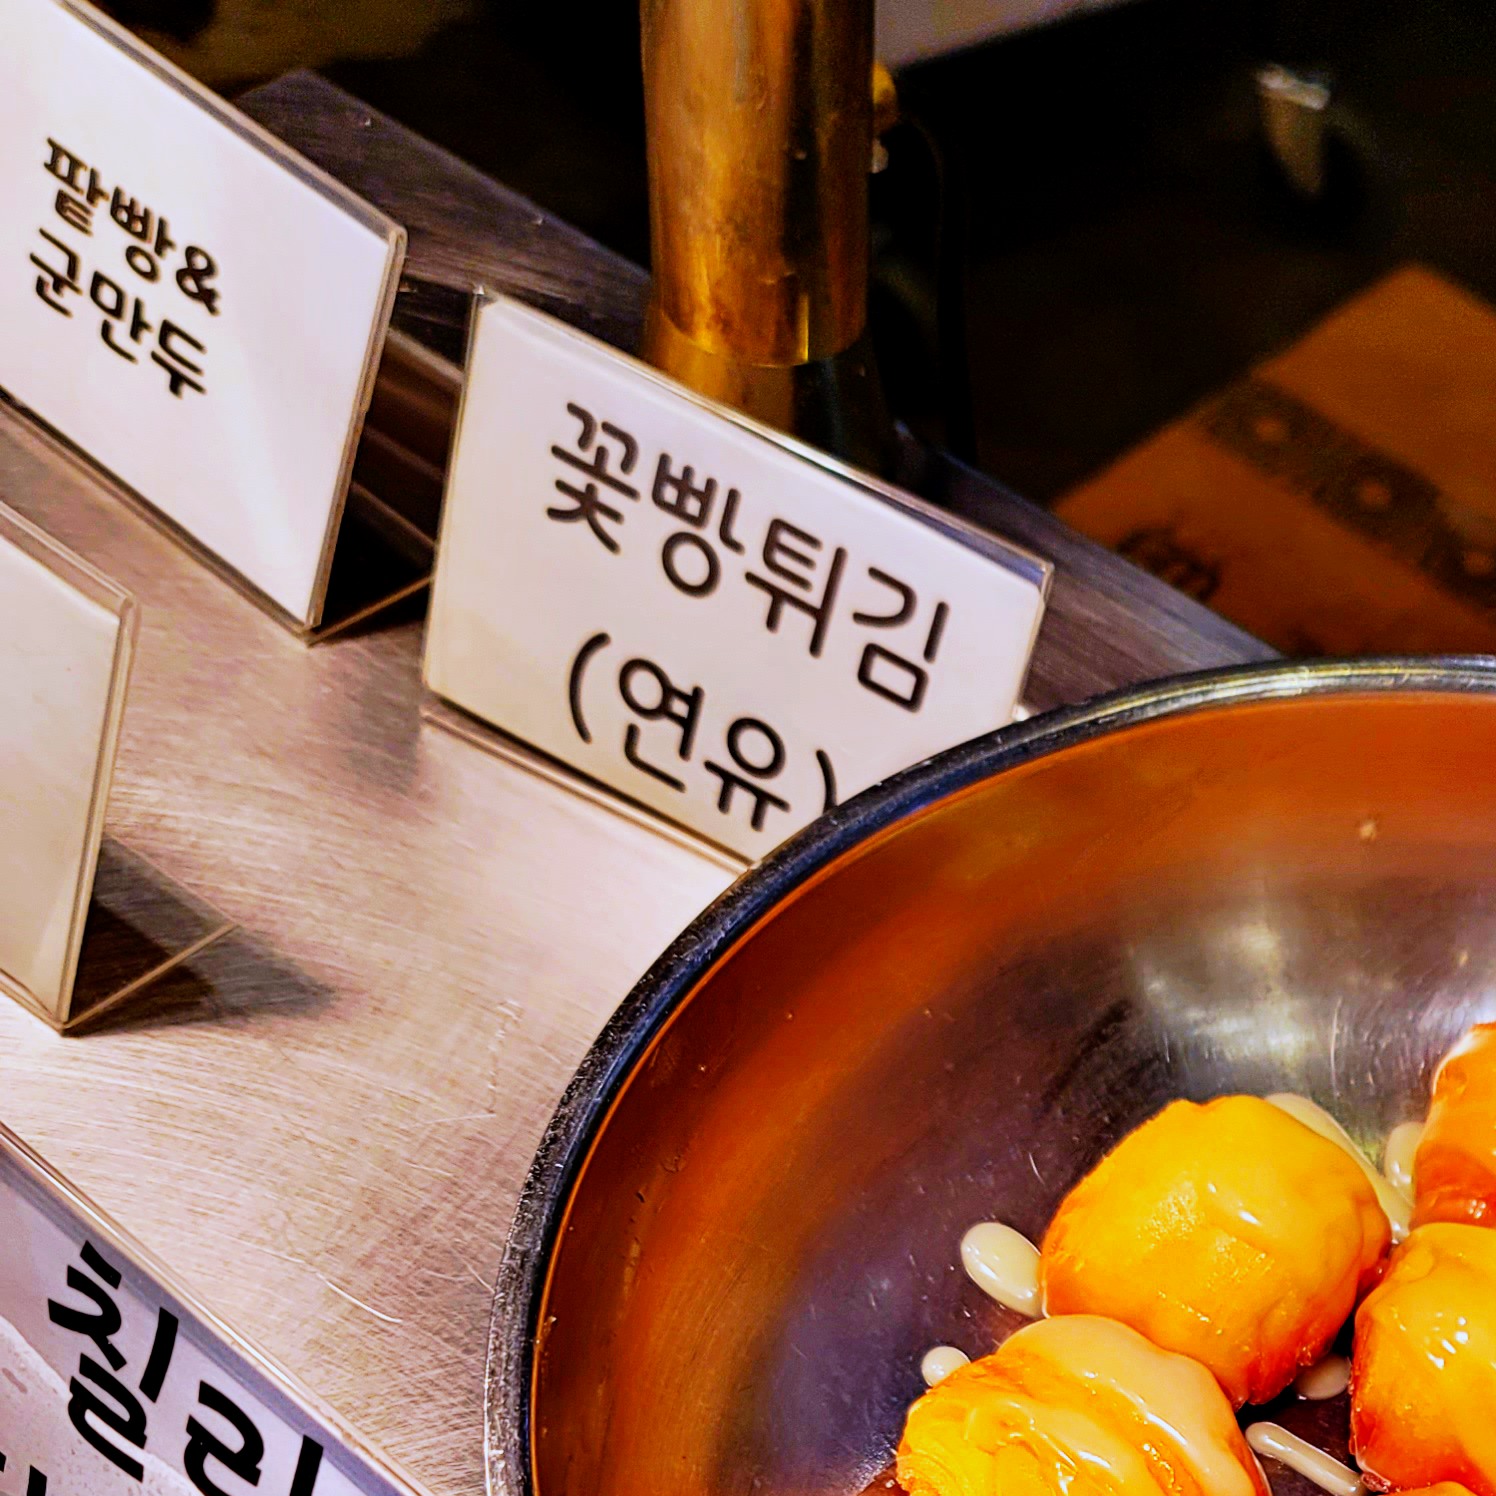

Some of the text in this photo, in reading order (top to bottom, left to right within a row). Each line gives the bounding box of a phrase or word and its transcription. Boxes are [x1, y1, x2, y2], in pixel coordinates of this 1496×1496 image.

[29, 228, 206, 399] 군만두
[43, 137, 220, 316] 팥빵&
[546, 402, 949, 713] 꽃빵튀김
